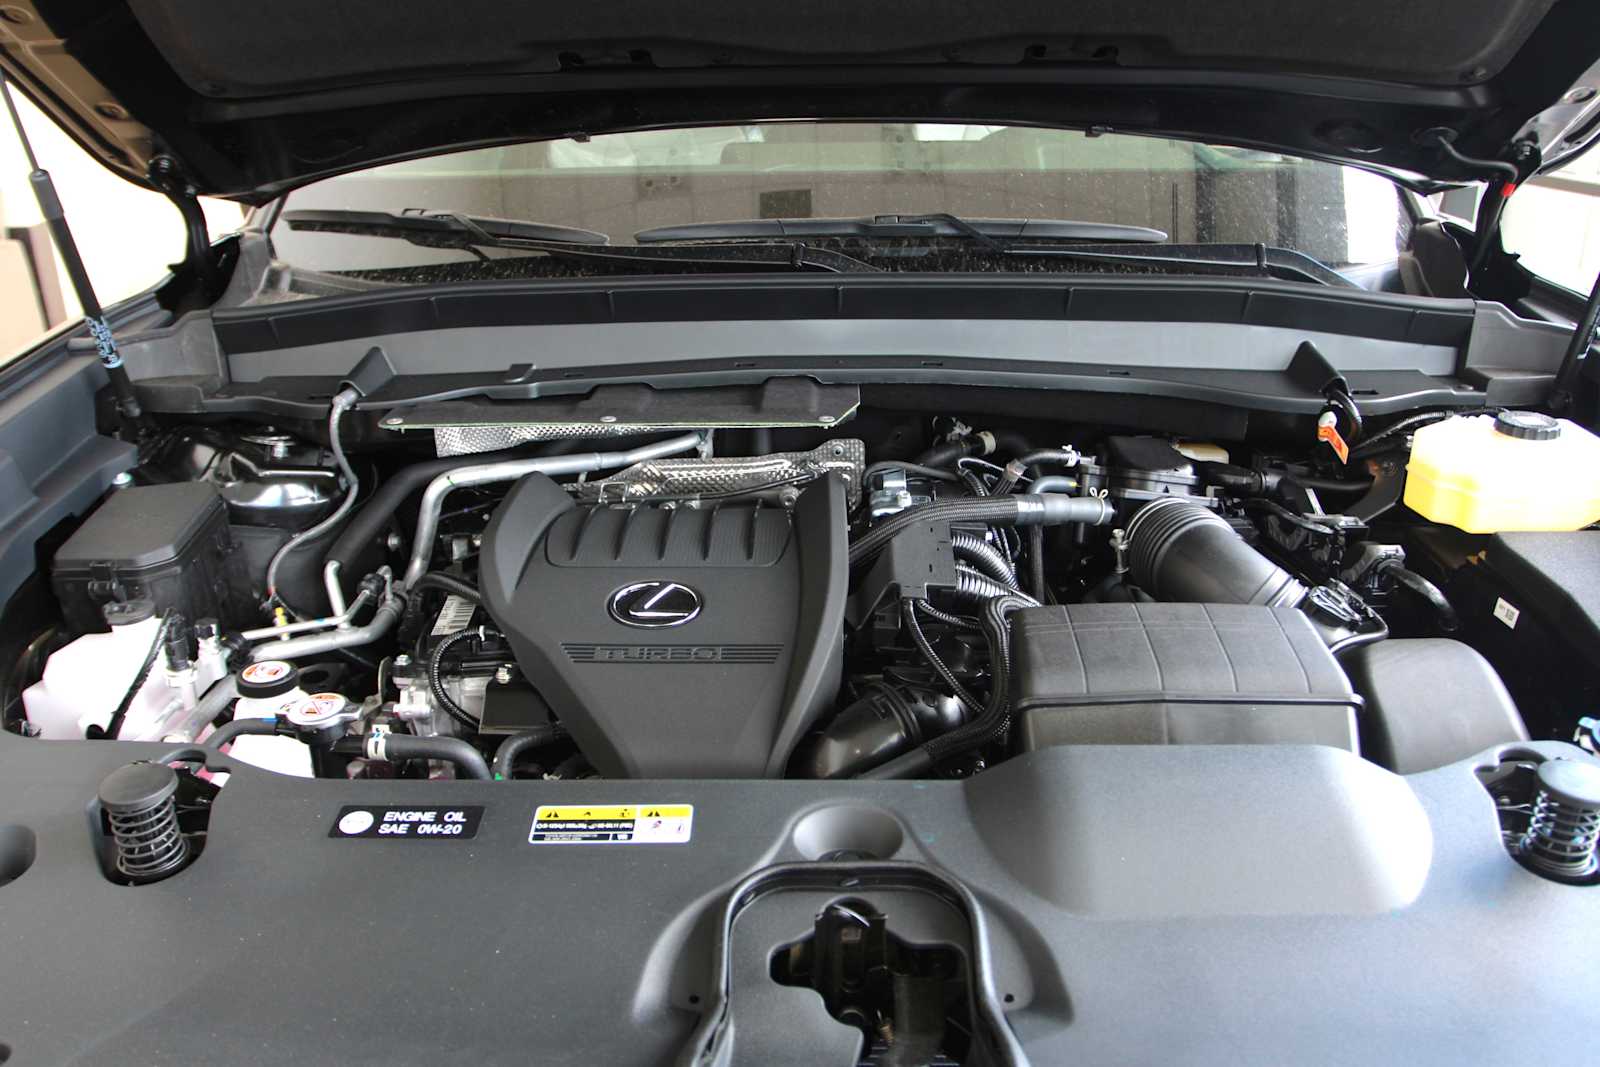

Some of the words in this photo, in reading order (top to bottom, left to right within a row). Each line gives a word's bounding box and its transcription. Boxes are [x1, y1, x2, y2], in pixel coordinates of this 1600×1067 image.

[594, 646, 721, 659] TURBO
[383, 811, 437, 822] ENGINE
[443, 811, 467, 822] OIL
[378, 823, 410, 834] SAE
[417, 823, 462, 834] 0W-20
